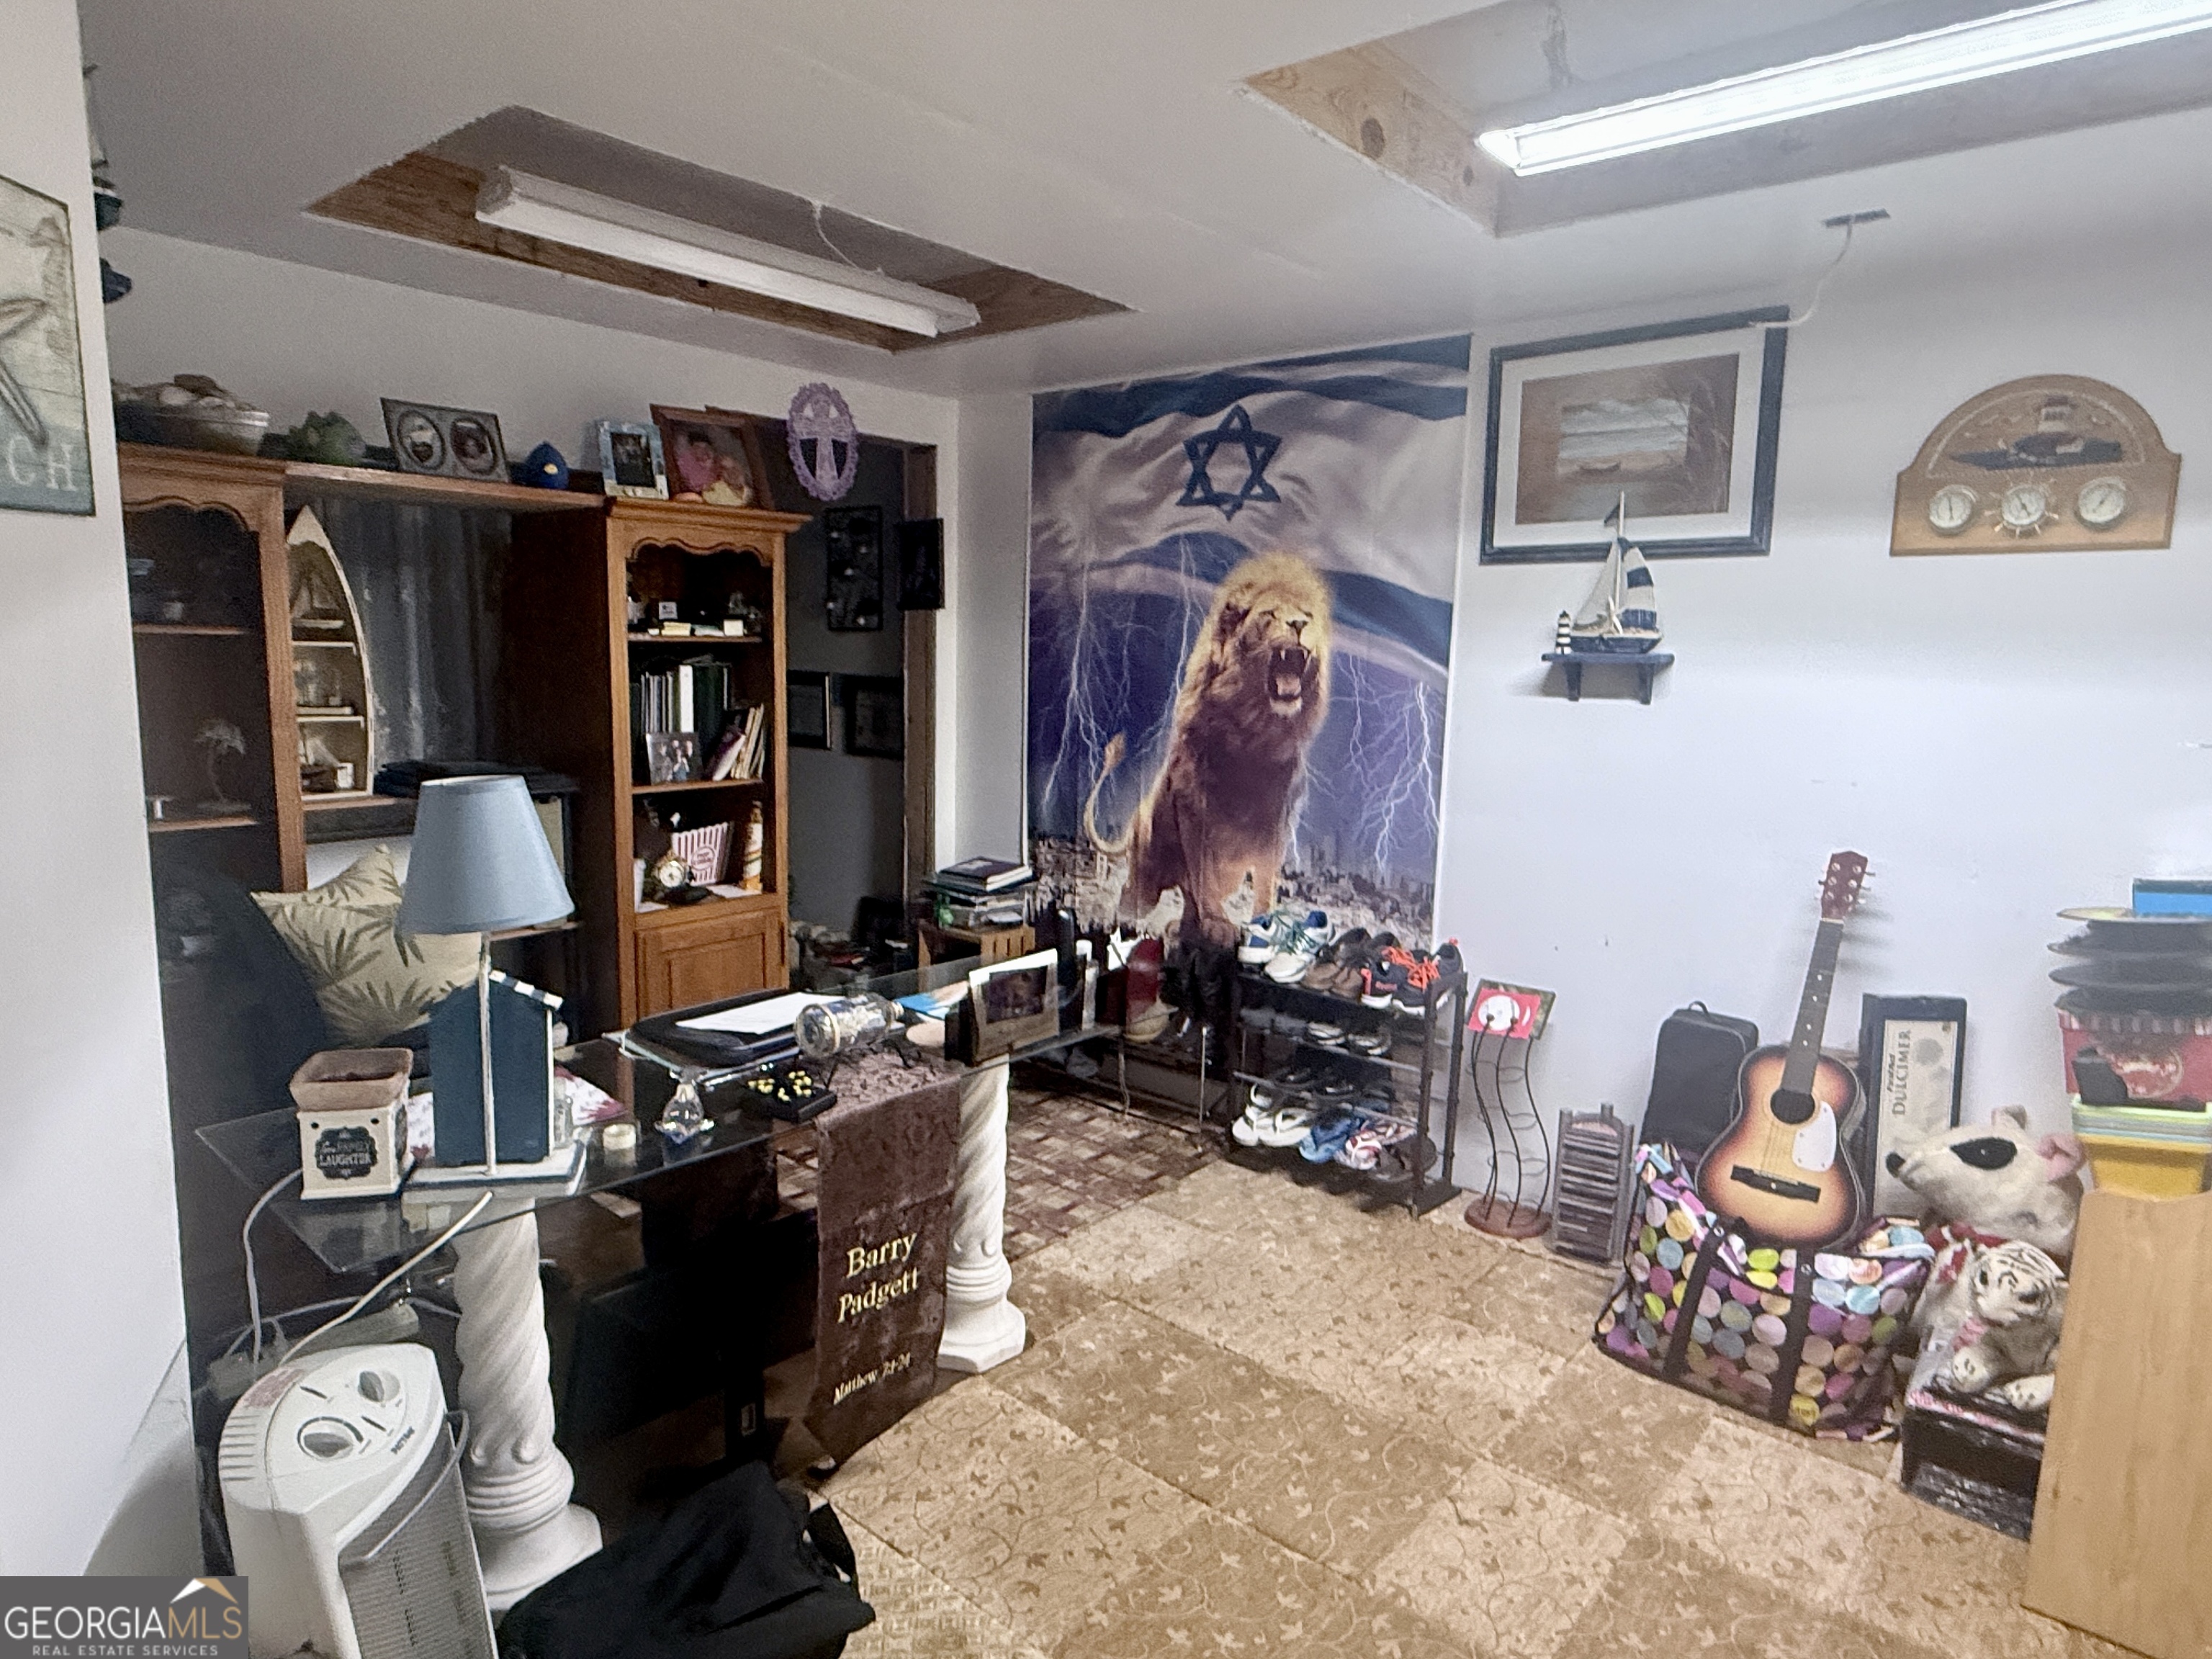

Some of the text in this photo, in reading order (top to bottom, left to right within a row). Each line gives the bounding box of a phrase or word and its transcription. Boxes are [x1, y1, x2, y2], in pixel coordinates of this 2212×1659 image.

[1892, 1029, 1911, 1115] DULCIMER
[845, 1232, 918, 1280] Barry
[837, 1267, 920, 1323] Padgett
